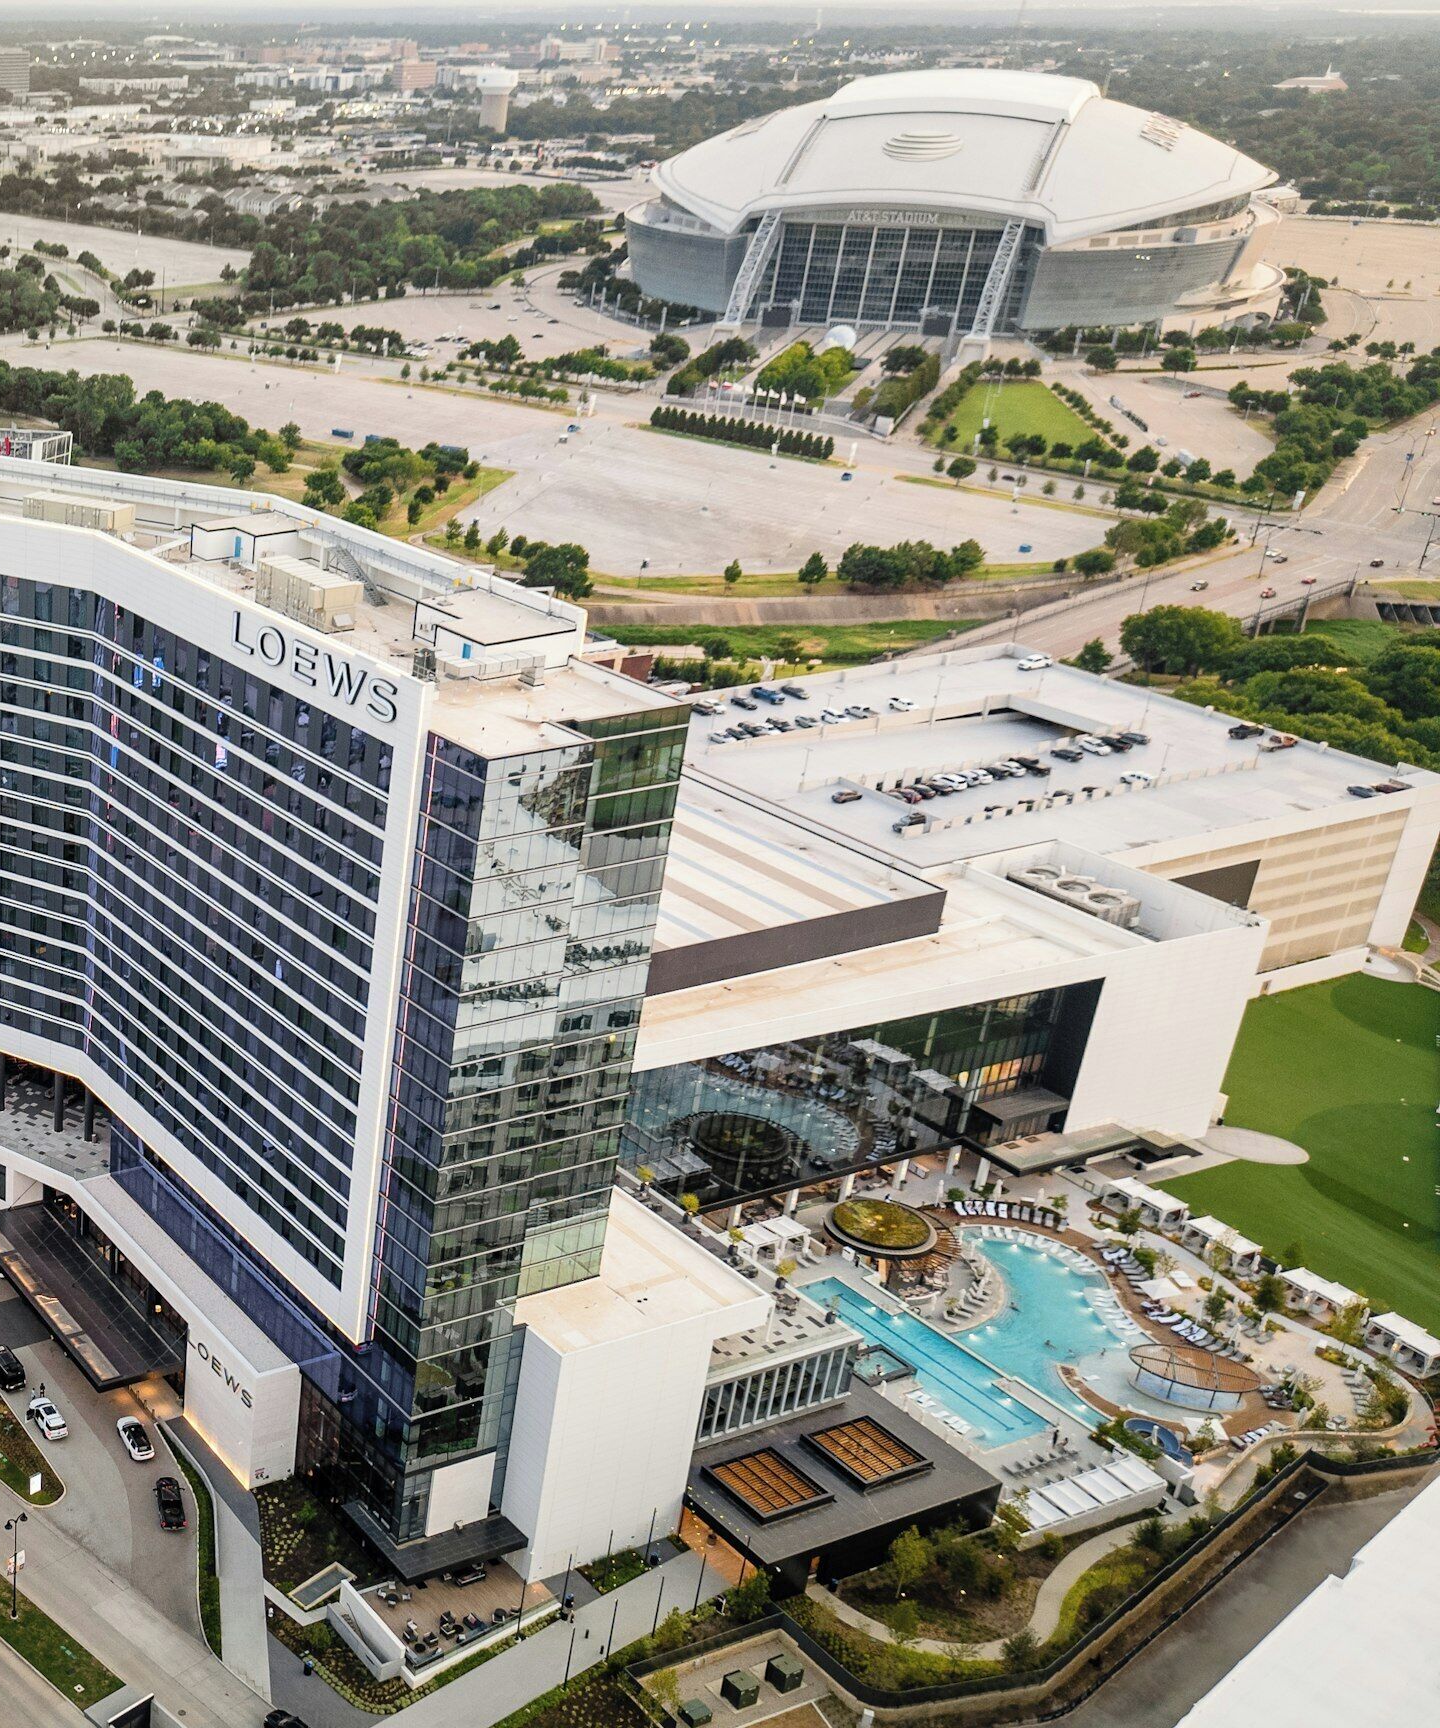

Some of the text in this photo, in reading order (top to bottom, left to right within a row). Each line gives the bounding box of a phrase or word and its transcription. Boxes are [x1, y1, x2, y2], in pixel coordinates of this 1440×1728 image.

[847, 209, 939, 225] AT&T STADIUM
[231, 610, 398, 724] LOEWS
